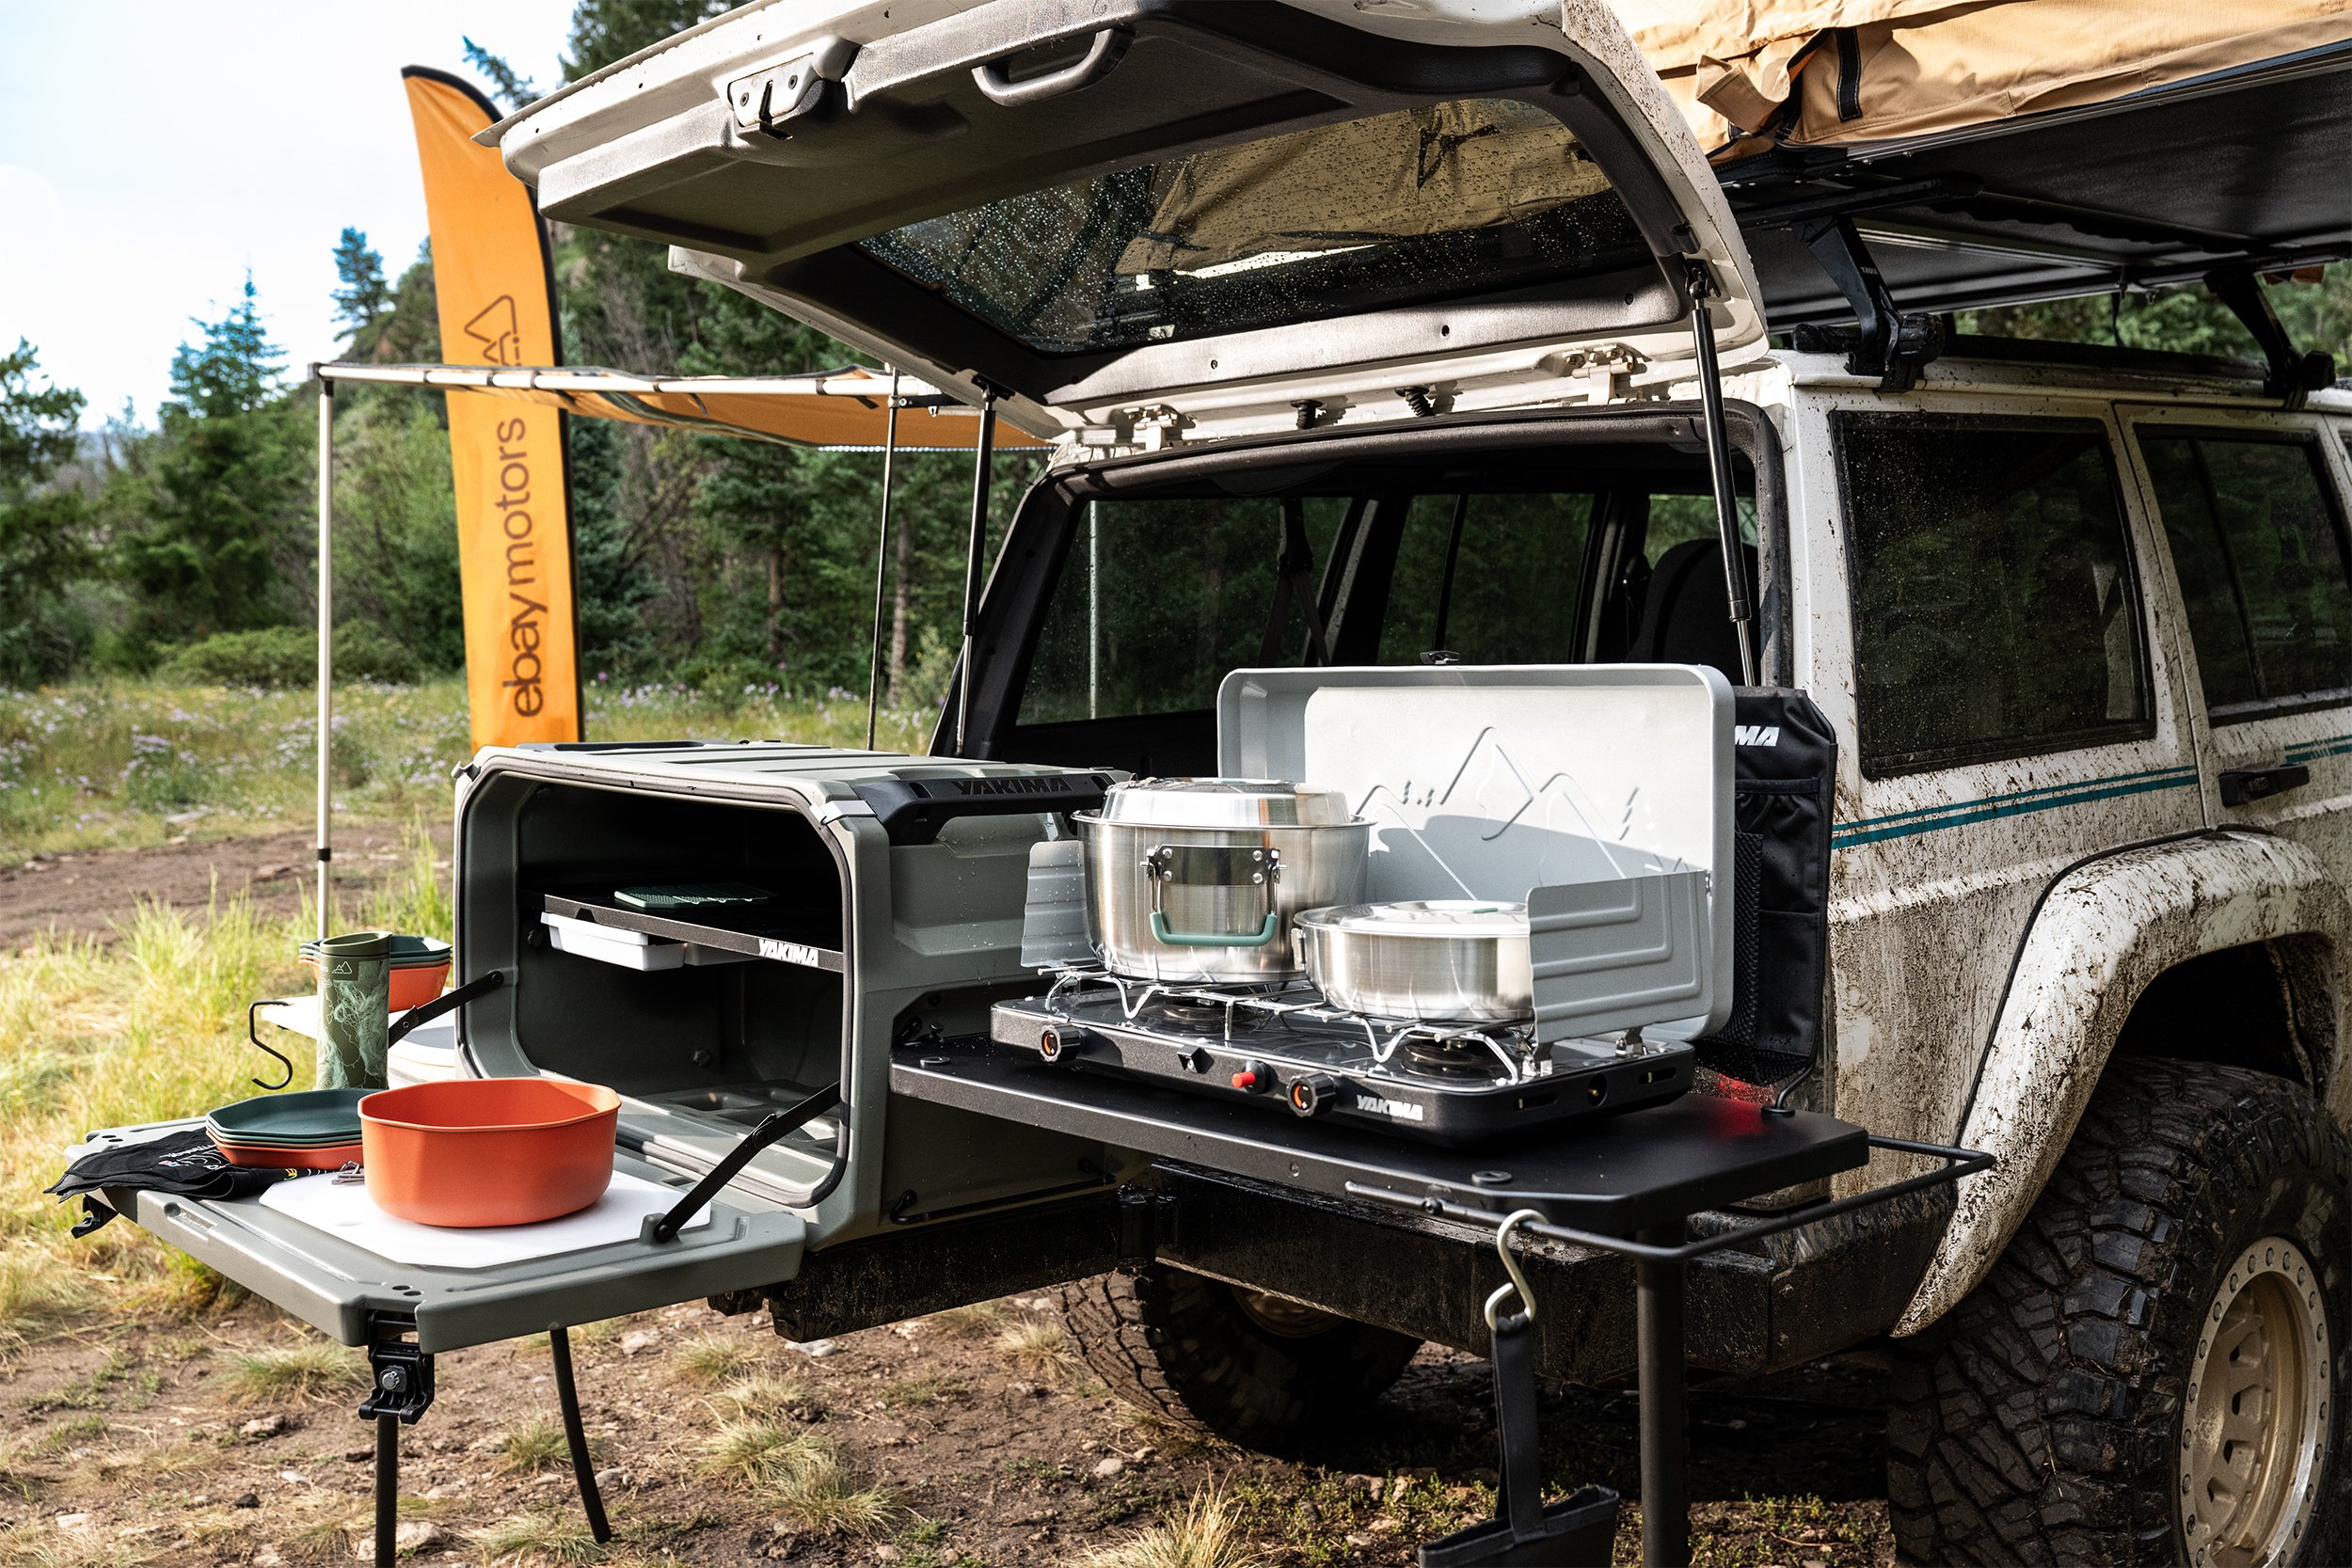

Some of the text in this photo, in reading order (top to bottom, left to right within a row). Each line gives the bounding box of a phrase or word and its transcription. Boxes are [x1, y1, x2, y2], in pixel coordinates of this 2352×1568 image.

[1735, 725, 1780, 747] MA
[950, 778, 1073, 795] YAKIMA
[758, 939, 818, 967] YAKIMA
[1357, 1094, 1423, 1121] YAKIMA
